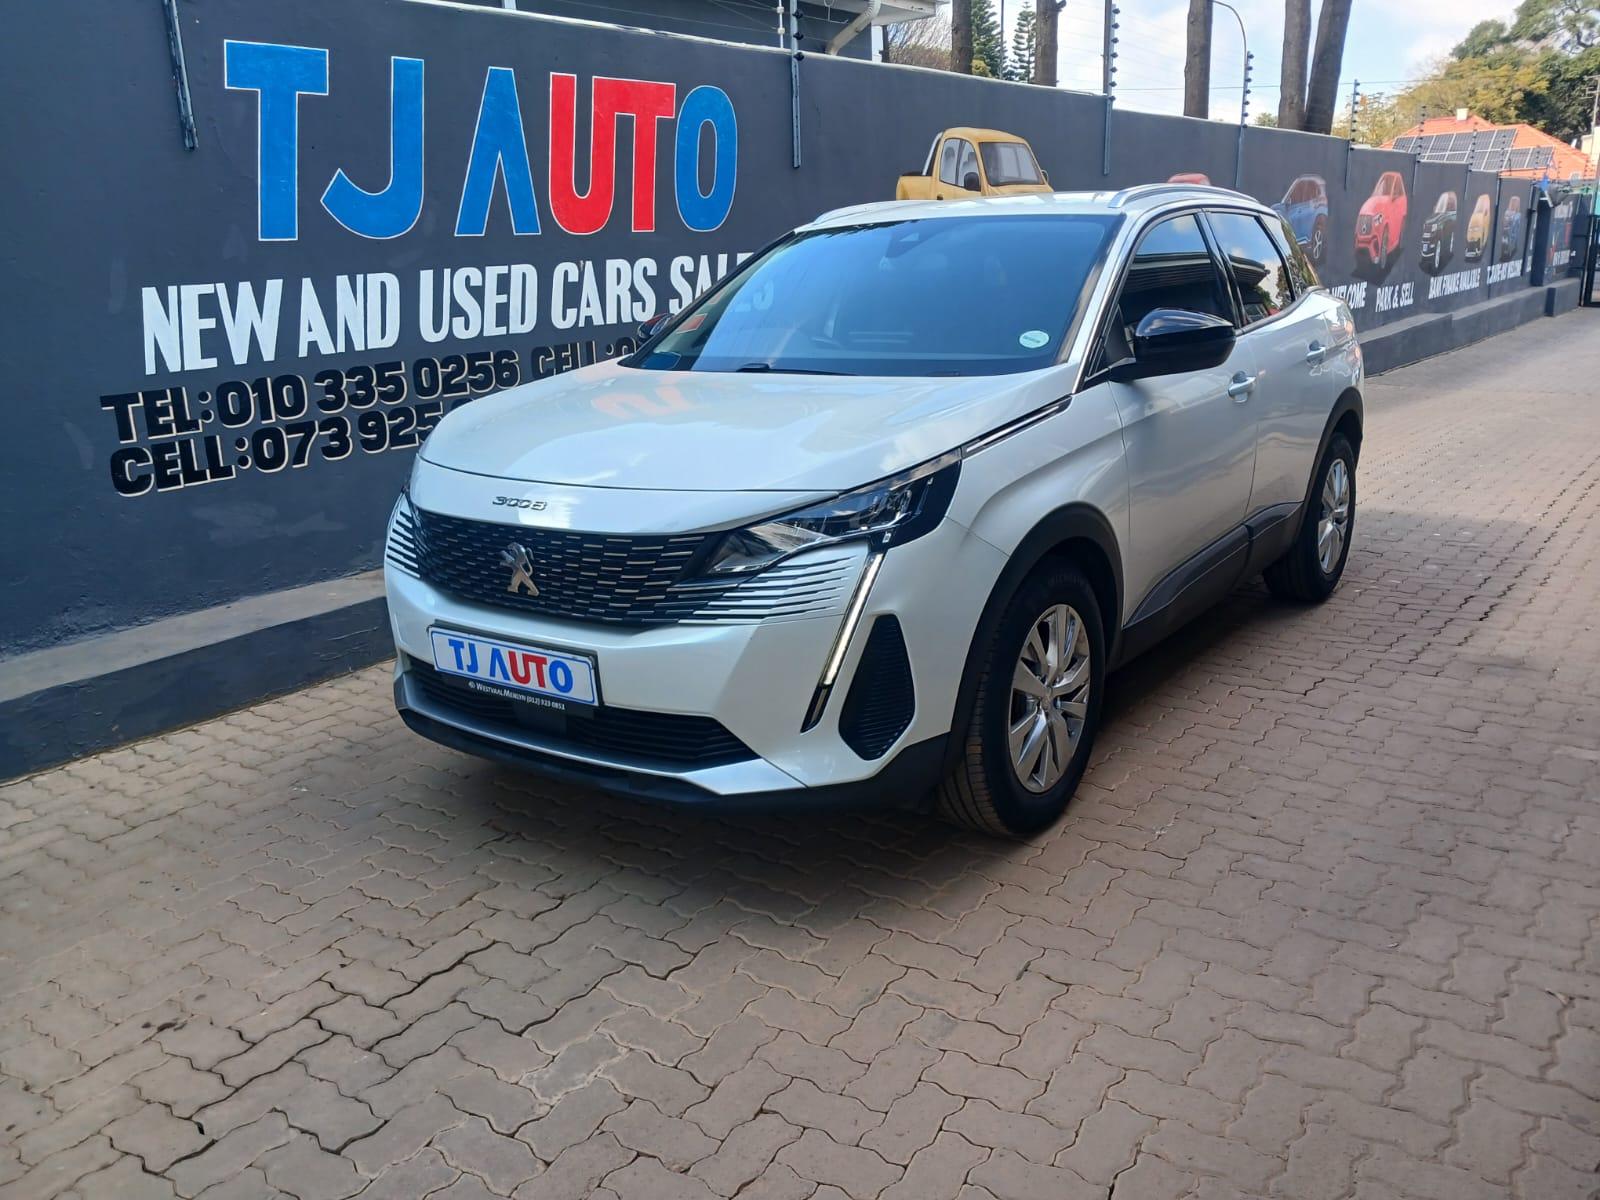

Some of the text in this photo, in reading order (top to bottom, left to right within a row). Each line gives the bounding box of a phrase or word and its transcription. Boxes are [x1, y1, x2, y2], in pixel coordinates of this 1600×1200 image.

[224, 39, 738, 241] TJ AUTO
[142, 279, 283, 375] NEW
[298, 272, 400, 357] AND
[419, 264, 538, 342] USED
[551, 257, 657, 330] CARS
[1375, 281, 1414, 312] PARK & SELL
[314, 361, 408, 415] 335
[413, 350, 520, 400] 0256
[358, 401, 443, 453] 925
[492, 496, 547, 511] 3008
[448, 639, 573, 693] TJ AUTO
